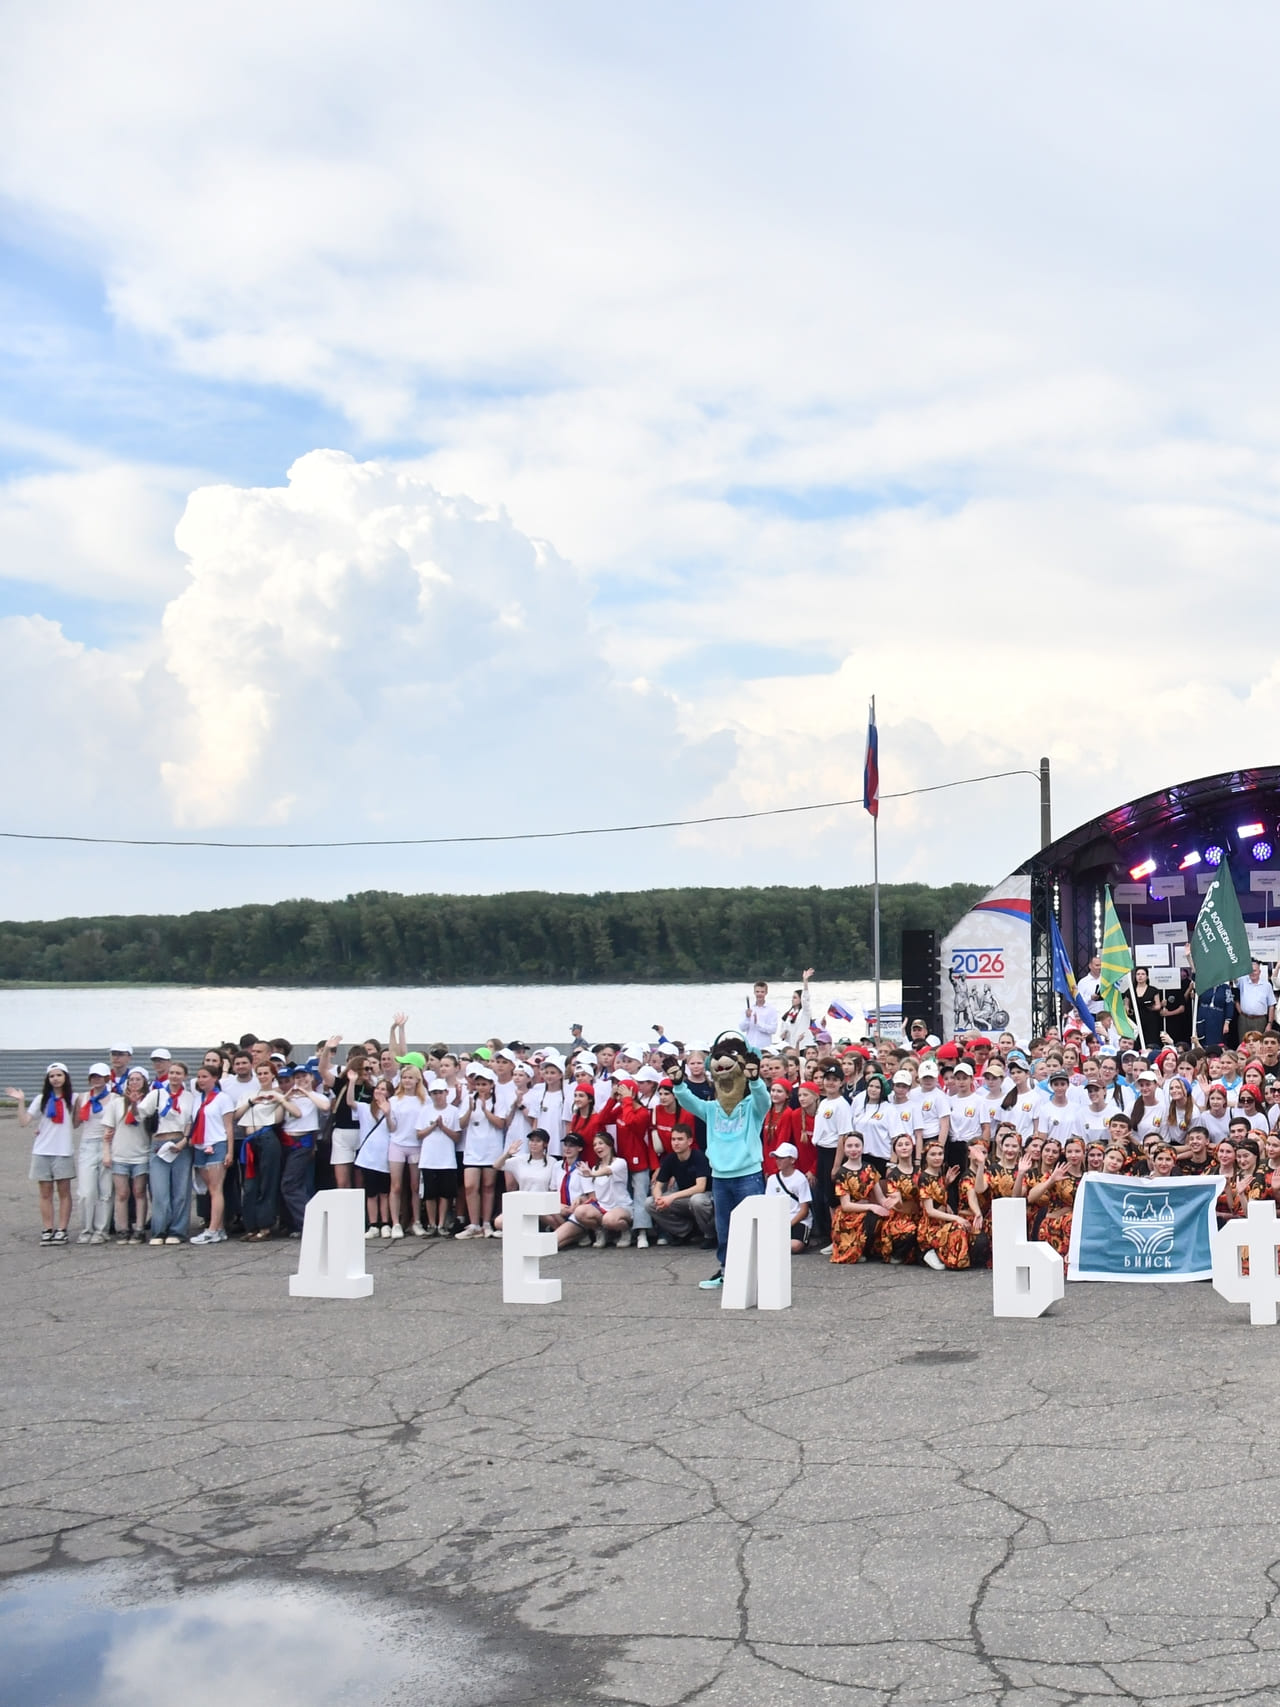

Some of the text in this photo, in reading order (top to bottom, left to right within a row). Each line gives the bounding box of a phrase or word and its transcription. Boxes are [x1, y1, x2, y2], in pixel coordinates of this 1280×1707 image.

[1200, 918, 1217, 943] ХОЛСТ
[1210, 911, 1239, 964] ВОЛШЕБНЫЙ
[952, 953, 1005, 973] 2026
[1123, 1254, 1172, 1268] БИЙСК
